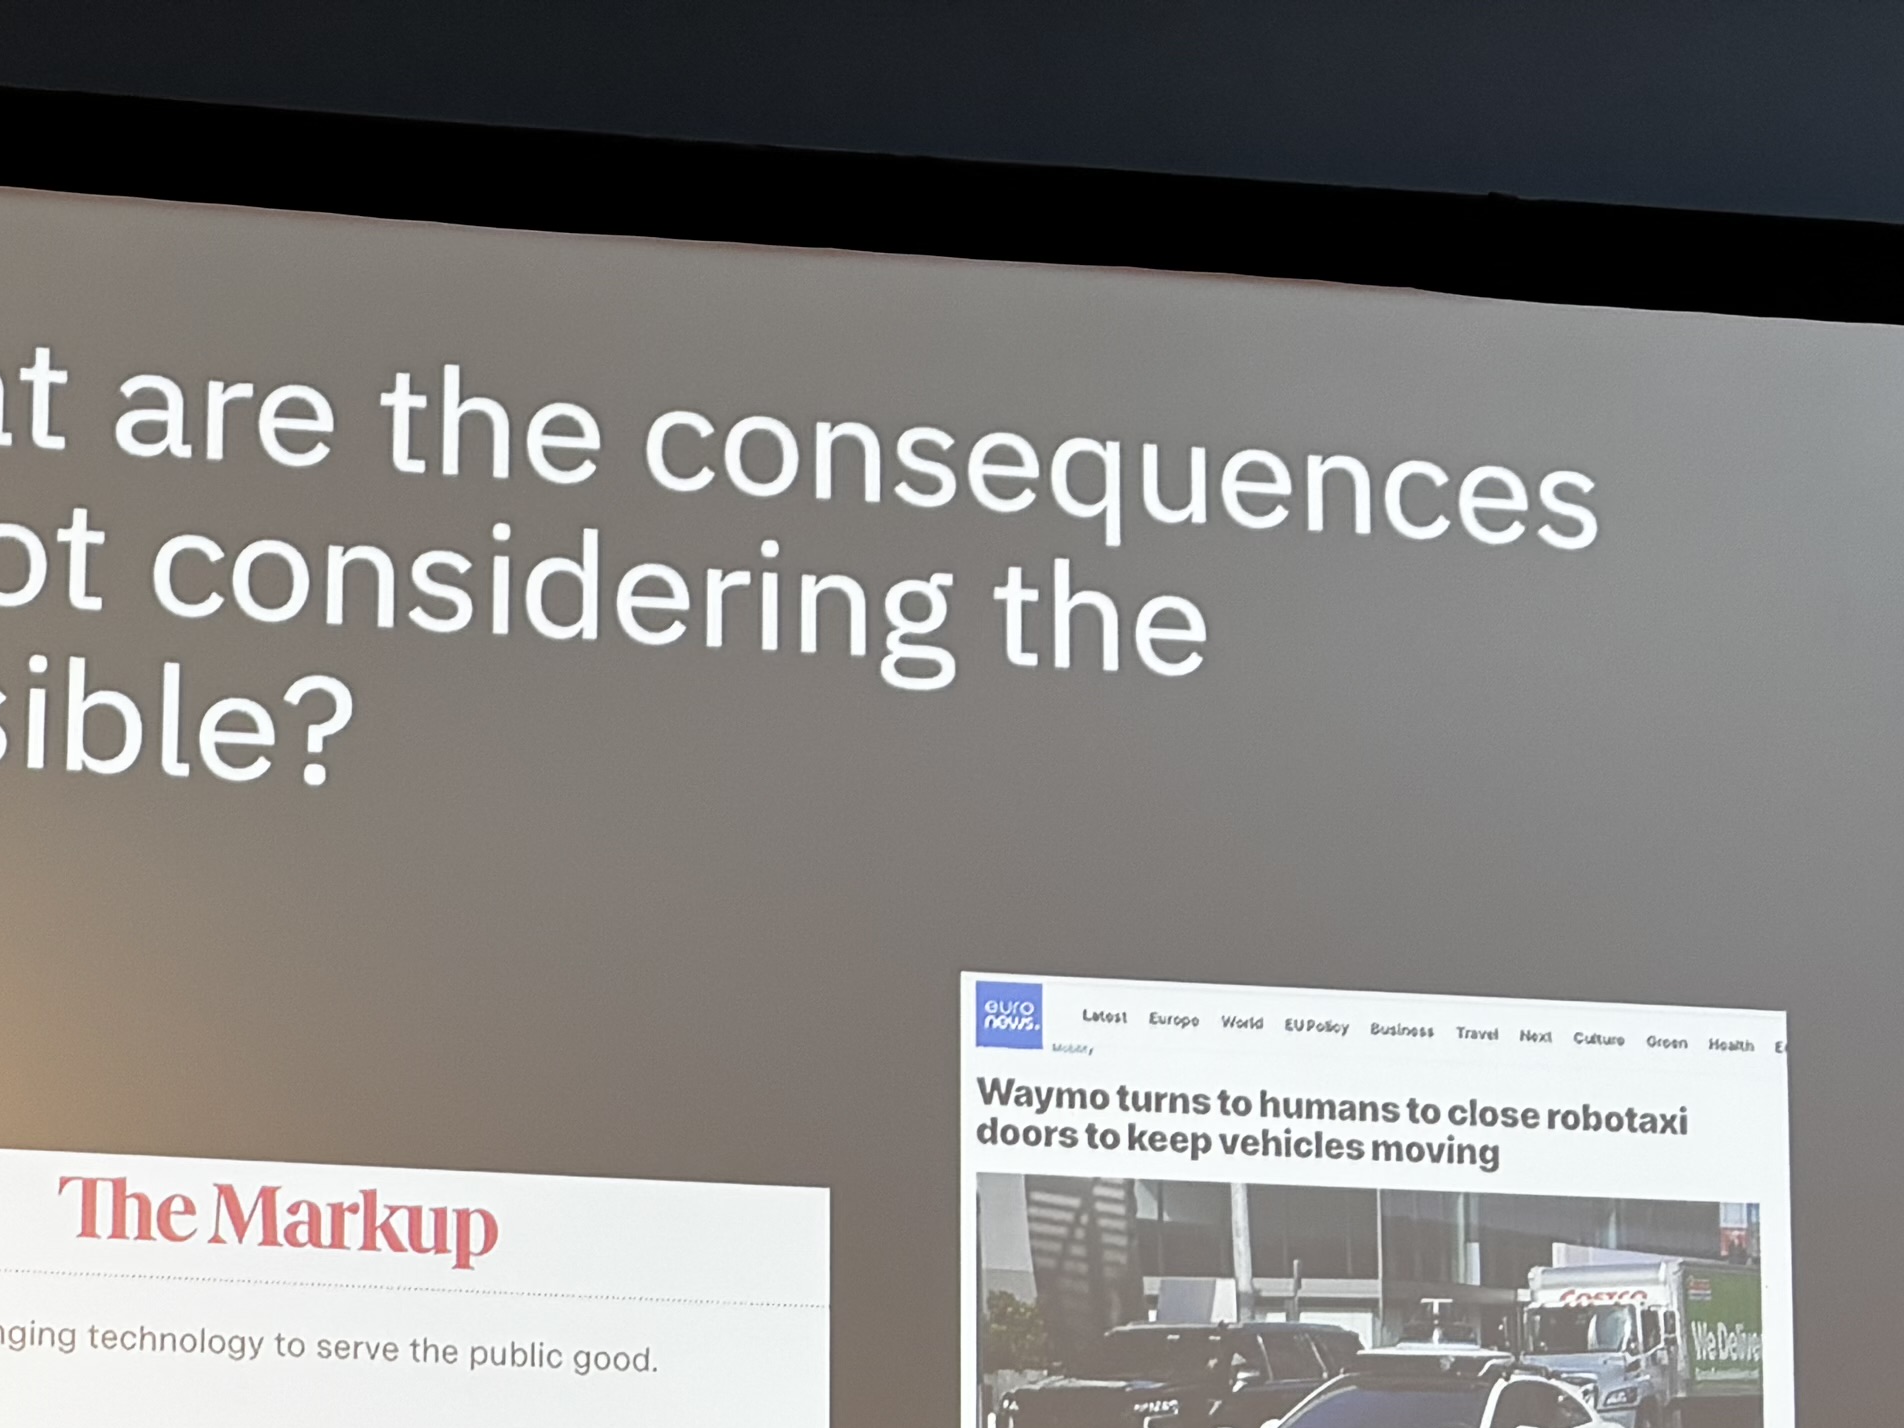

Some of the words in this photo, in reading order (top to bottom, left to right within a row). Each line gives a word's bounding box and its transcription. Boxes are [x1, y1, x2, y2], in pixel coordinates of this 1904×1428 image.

[115, 375, 334, 467] are
[380, 364, 600, 484] the
[646, 411, 1597, 549] consequences
[153, 523, 955, 690] considering
[994, 558, 1206, 676] the
[984, 1000, 1035, 1016] euro
[1083, 1009, 1127, 1024] Latest
[1149, 1012, 1199, 1029] Europe
[1221, 1015, 1263, 1029] World
[1371, 1022, 1434, 1038] Business
[1456, 1026, 1498, 1040] Travel
[1520, 1030, 1552, 1043] Next
[1574, 1032, 1625, 1046] Culture
[1646, 1035, 1688, 1049] Green
[1709, 1038, 1755, 1052] Health
[977, 1077, 1109, 1114] Waymo
[1116, 1085, 1211, 1115] turns
[1217, 1090, 1252, 1116] to
[1260, 1090, 1400, 1123] humans
[1406, 1098, 1441, 1124] to
[1448, 1099, 1540, 1129] close
[1548, 1104, 1687, 1135] robotaxi
[977, 1117, 1078, 1148] doors
[1085, 1123, 1120, 1150] to
[1128, 1123, 1212, 1161] keep
[1219, 1128, 1365, 1160] vehicles
[1372, 1135, 1499, 1173] moving
[58, 1176, 197, 1242] The
[208, 1183, 498, 1270] Markup
[88, 1325, 264, 1361] technology
[275, 1333, 305, 1358] to
[317, 1339, 399, 1362] serve
[410, 1337, 458, 1364] the
[471, 1341, 562, 1370] public
[573, 1347, 657, 1376] good.
